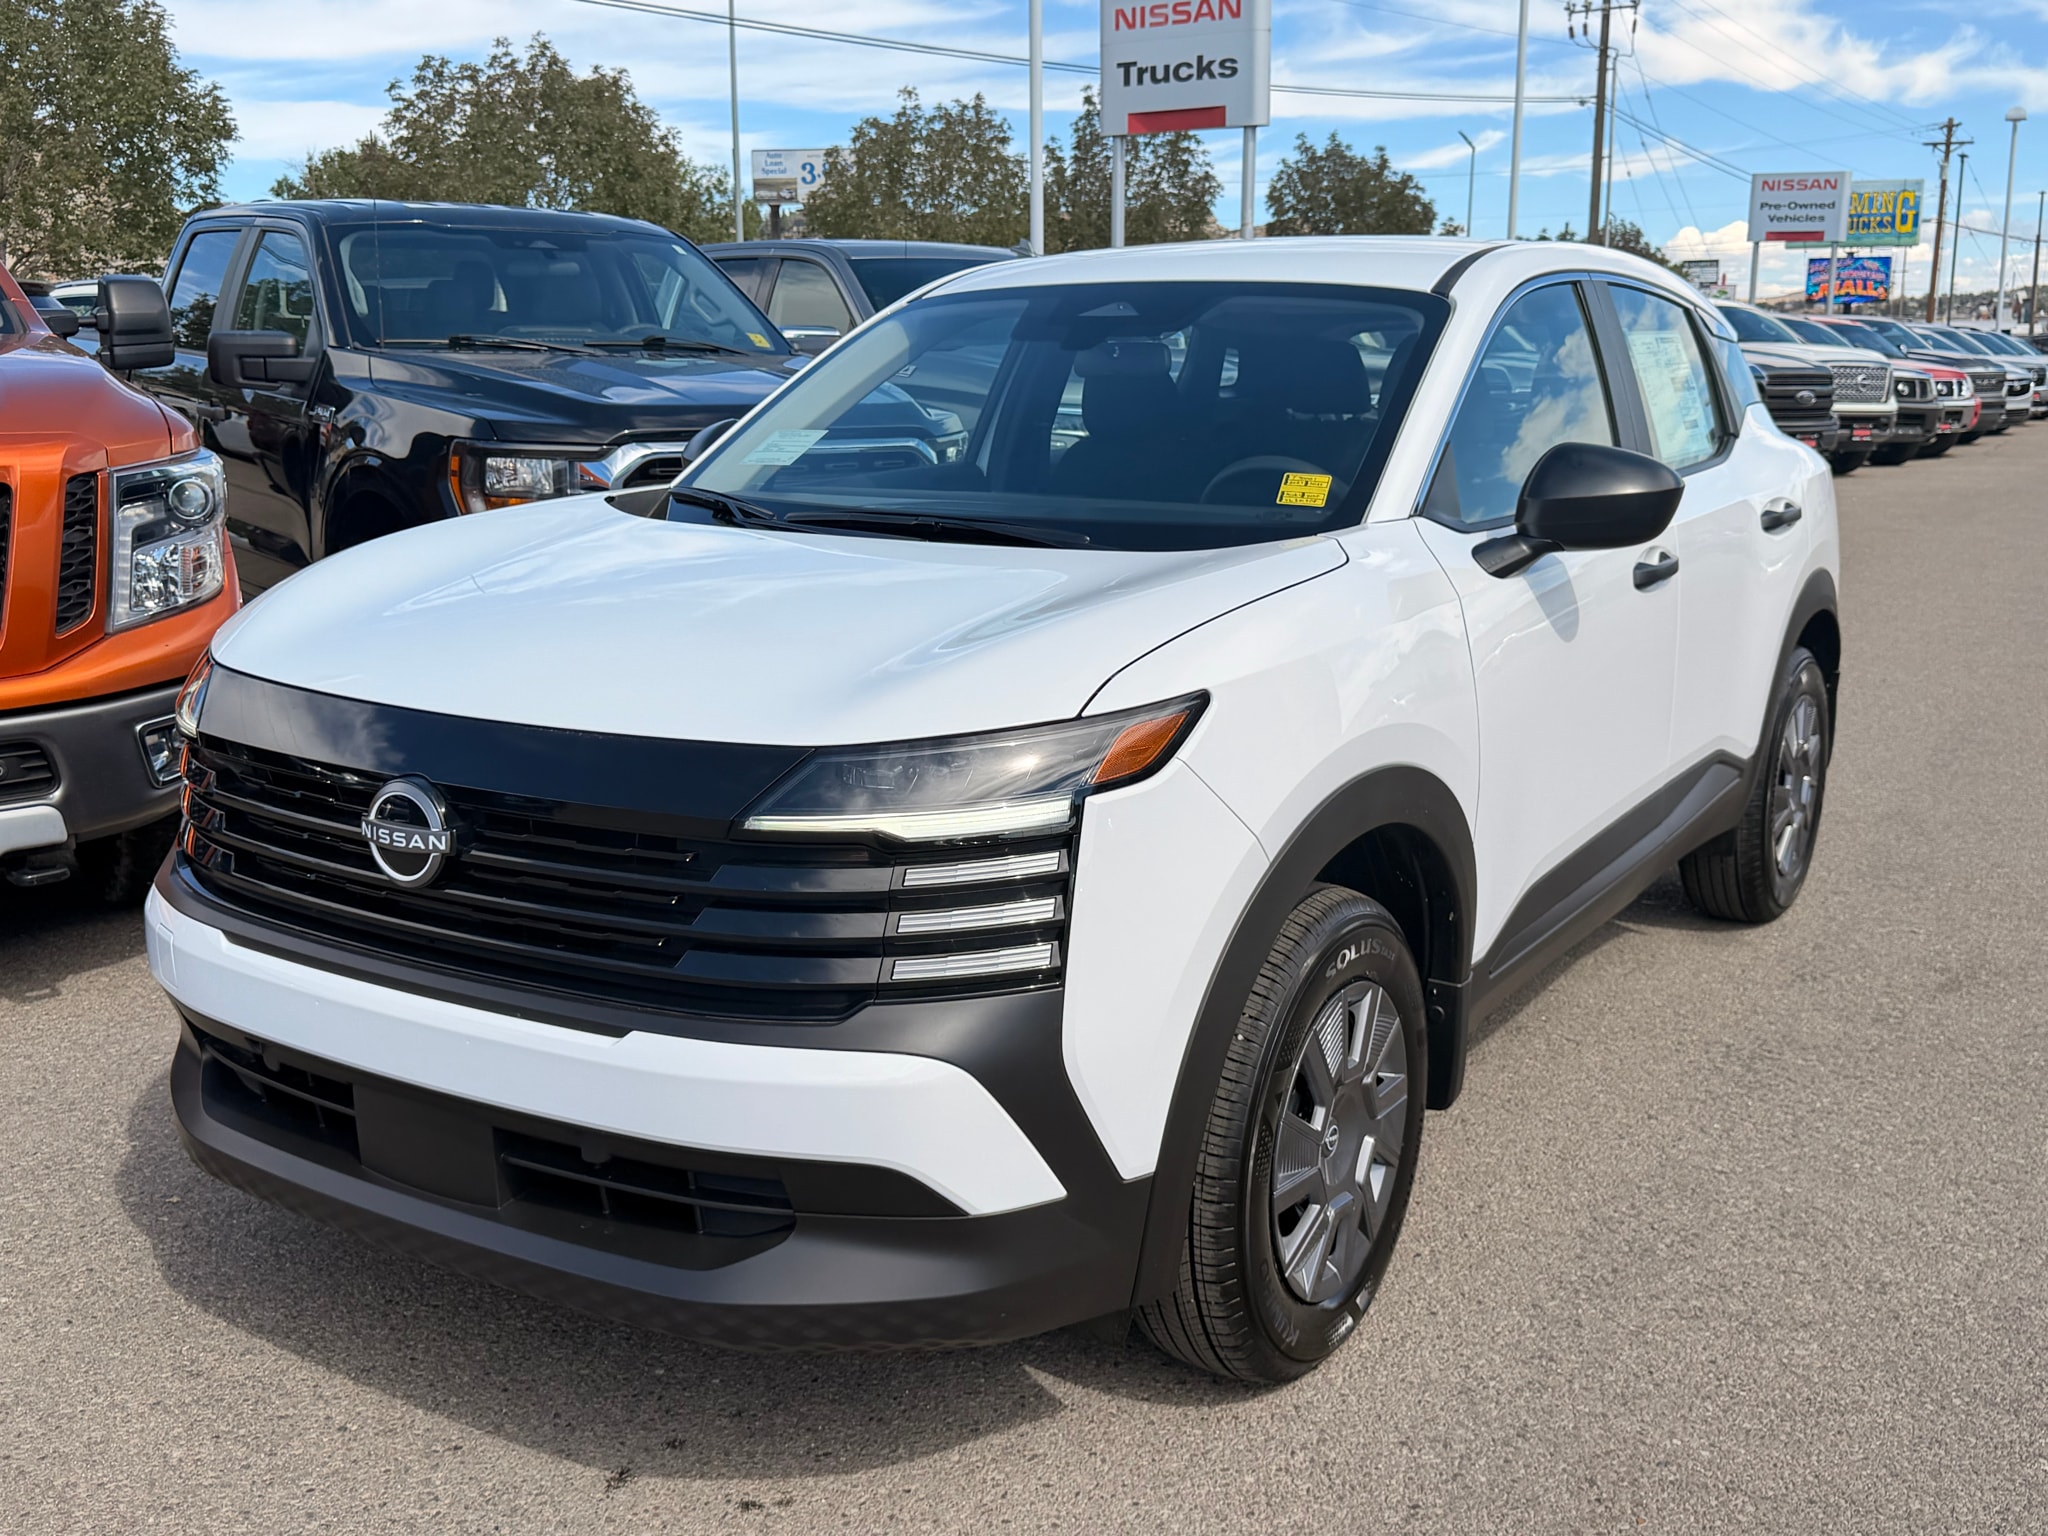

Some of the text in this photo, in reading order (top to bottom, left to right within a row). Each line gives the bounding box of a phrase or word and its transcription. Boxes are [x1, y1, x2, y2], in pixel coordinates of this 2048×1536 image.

[1115, 0, 1241, 31] NISSAN
[1116, 55, 1239, 87] Trucks
[761, 167, 787, 176] Special
[1761, 178, 1838, 192] NISSAN
[1759, 200, 1836, 211] Pre-Owned
[1768, 213, 1825, 223] Vehicles
[361, 820, 447, 851] NISSAN
[1325, 938, 1381, 978] SOLUS
